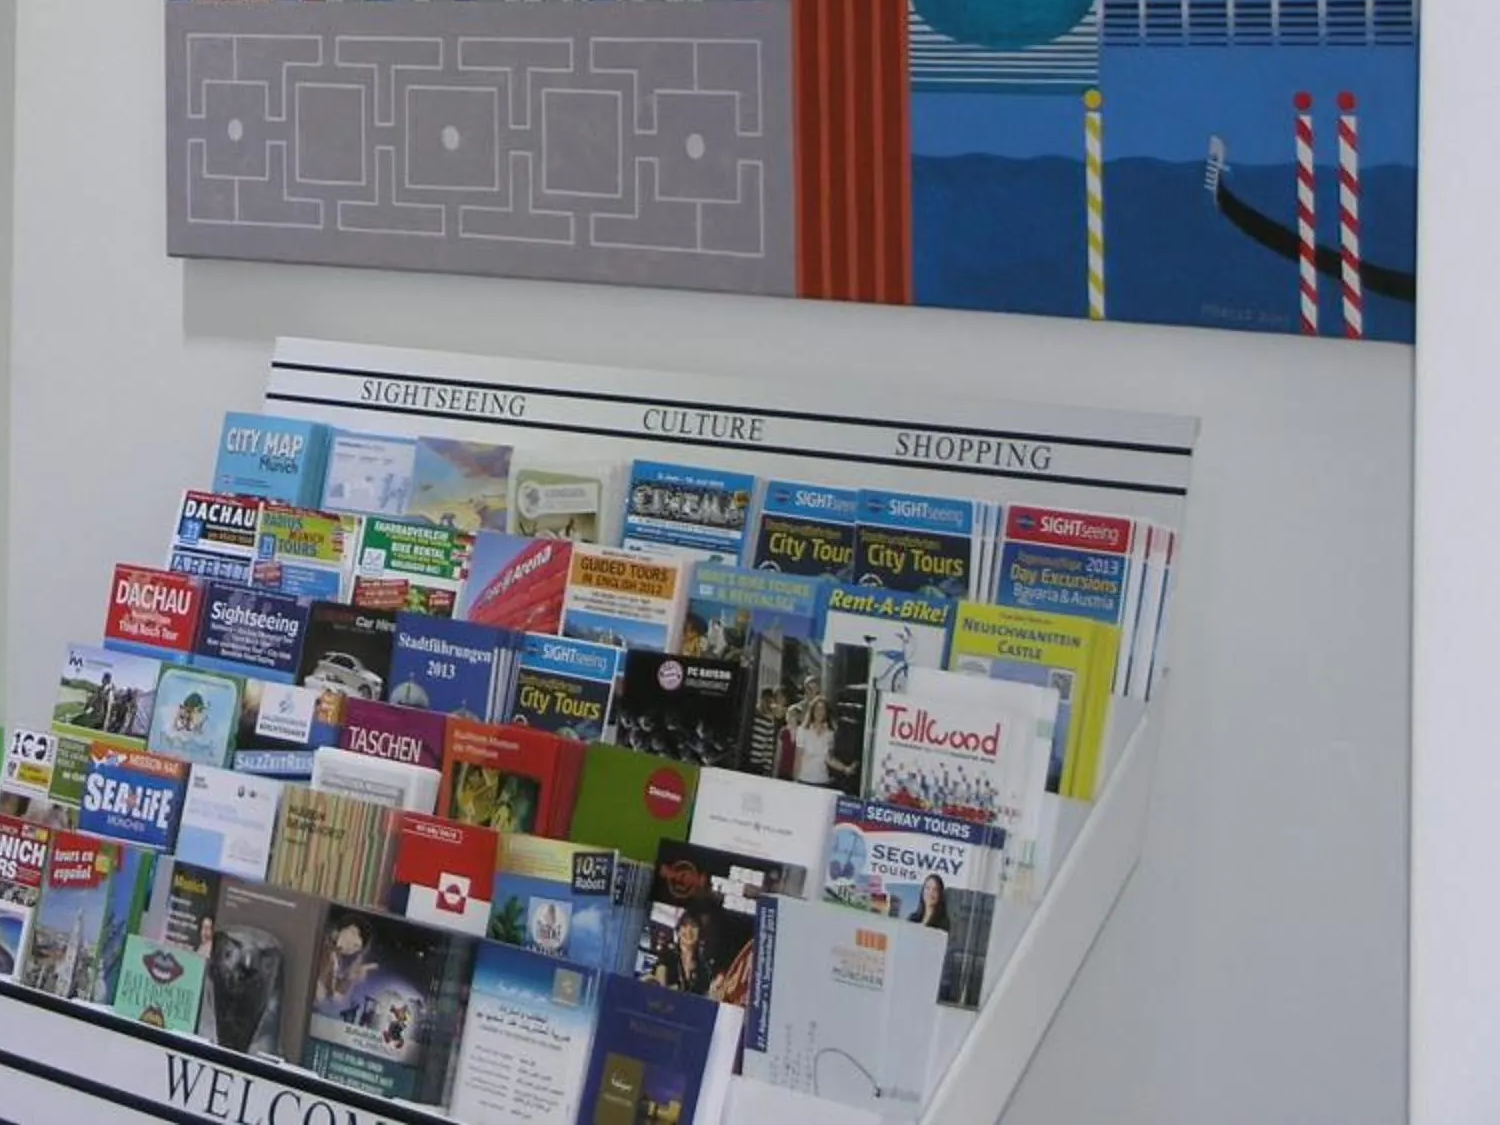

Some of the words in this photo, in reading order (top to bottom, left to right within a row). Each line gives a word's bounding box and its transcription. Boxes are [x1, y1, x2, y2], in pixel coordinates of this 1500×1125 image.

[361, 379, 527, 418] SIGHTSEEING
[643, 408, 765, 443] CULTURE
[226, 427, 261, 454] CITY
[263, 432, 304, 458] MAP
[895, 432, 1053, 472] SHOPPING
[258, 455, 300, 475] Munich
[183, 499, 256, 527] DACHAU
[1040, 515, 1120, 546] SIGHTseeing
[769, 531, 804, 561] City
[811, 538, 854, 565] Tour
[867, 543, 907, 573] City
[912, 548, 965, 577] Tours
[580, 555, 626, 576] GUIDED
[1010, 563, 1039, 585] Day
[1041, 568, 1118, 594] Excursions
[1084, 556, 1120, 575] 2013
[115, 579, 192, 615] DACHAU
[829, 588, 949, 623] Rent-A-Bike!
[211, 601, 300, 636] Sightseeing
[399, 632, 492, 664] Stadtführungen
[997, 640, 1043, 660] CASTLE
[426, 661, 457, 679] 2013
[520, 686, 550, 715] City
[554, 692, 602, 721] Tours
[348, 725, 422, 764] TASCHEN
[886, 703, 1002, 757] Tollwood
[83, 772, 132, 813] SEA
[866, 806, 921, 830] SEGWAY
[924, 817, 970, 839] TOURS
[871, 844, 964, 876] SEGWAY
[931, 842, 965, 858] CITY
[871, 862, 918, 881] TOURS
[165, 1052, 387, 1125] WELCO
